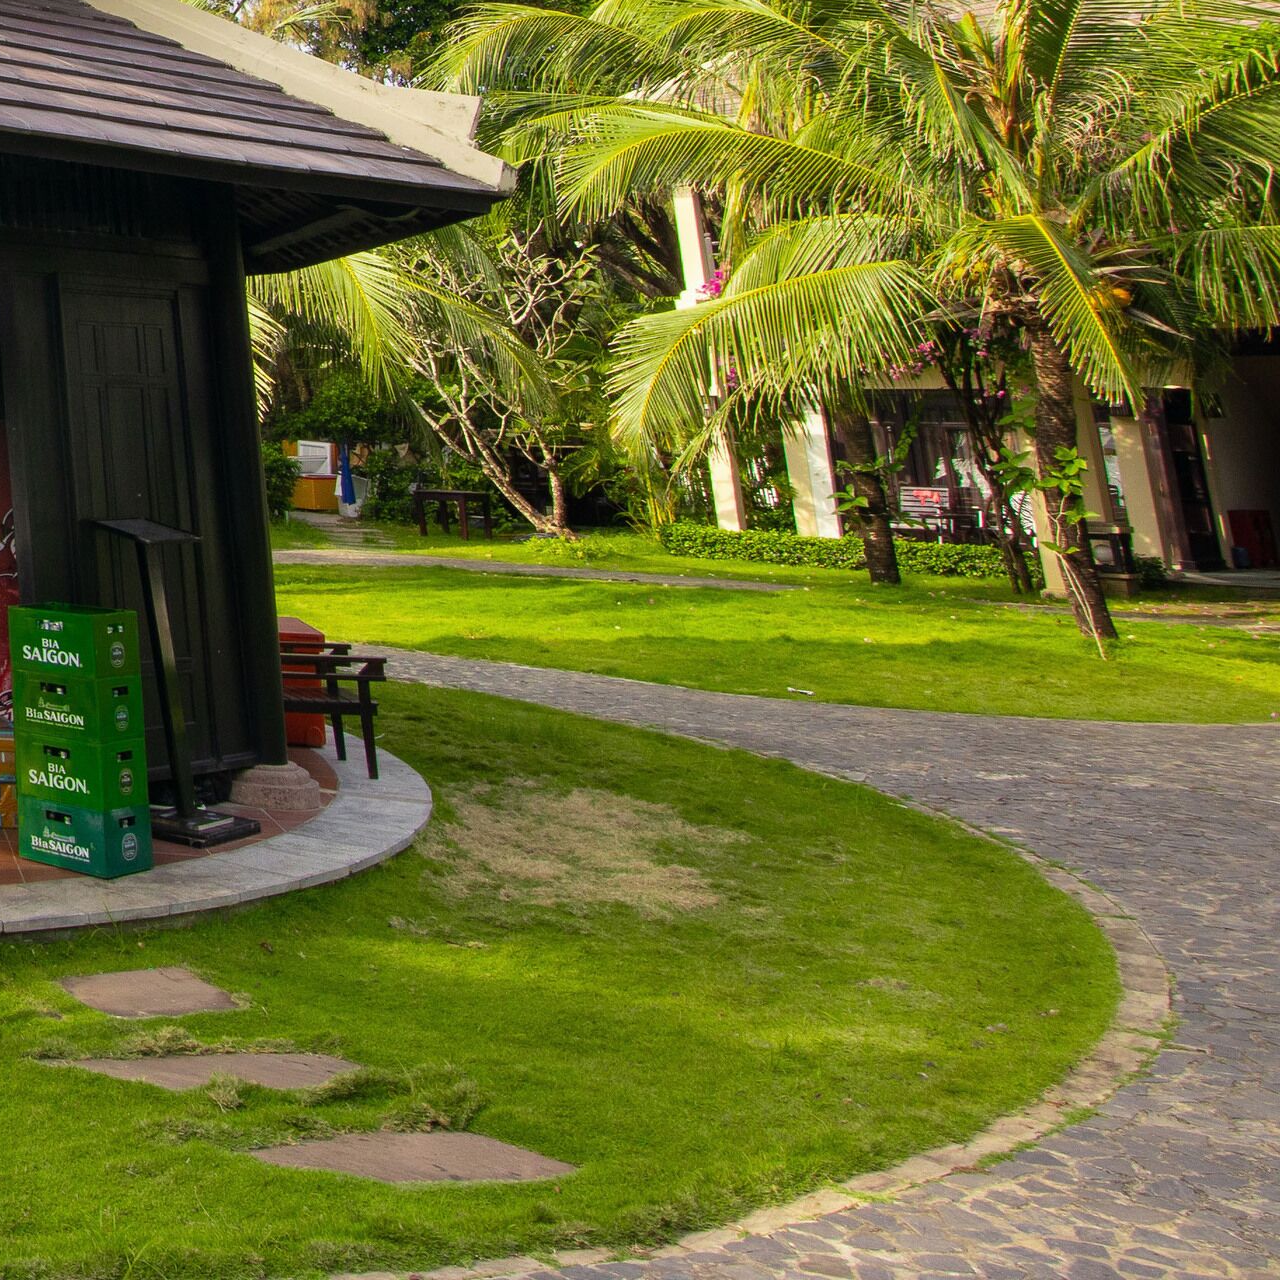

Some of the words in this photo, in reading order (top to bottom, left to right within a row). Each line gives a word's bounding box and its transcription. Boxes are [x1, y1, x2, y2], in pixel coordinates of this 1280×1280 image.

[42, 638, 60, 650] BIA
[23, 645, 81, 668] SAIGON
[48, 763, 66, 775] BIA
[29, 769, 88, 795] SAIGON
